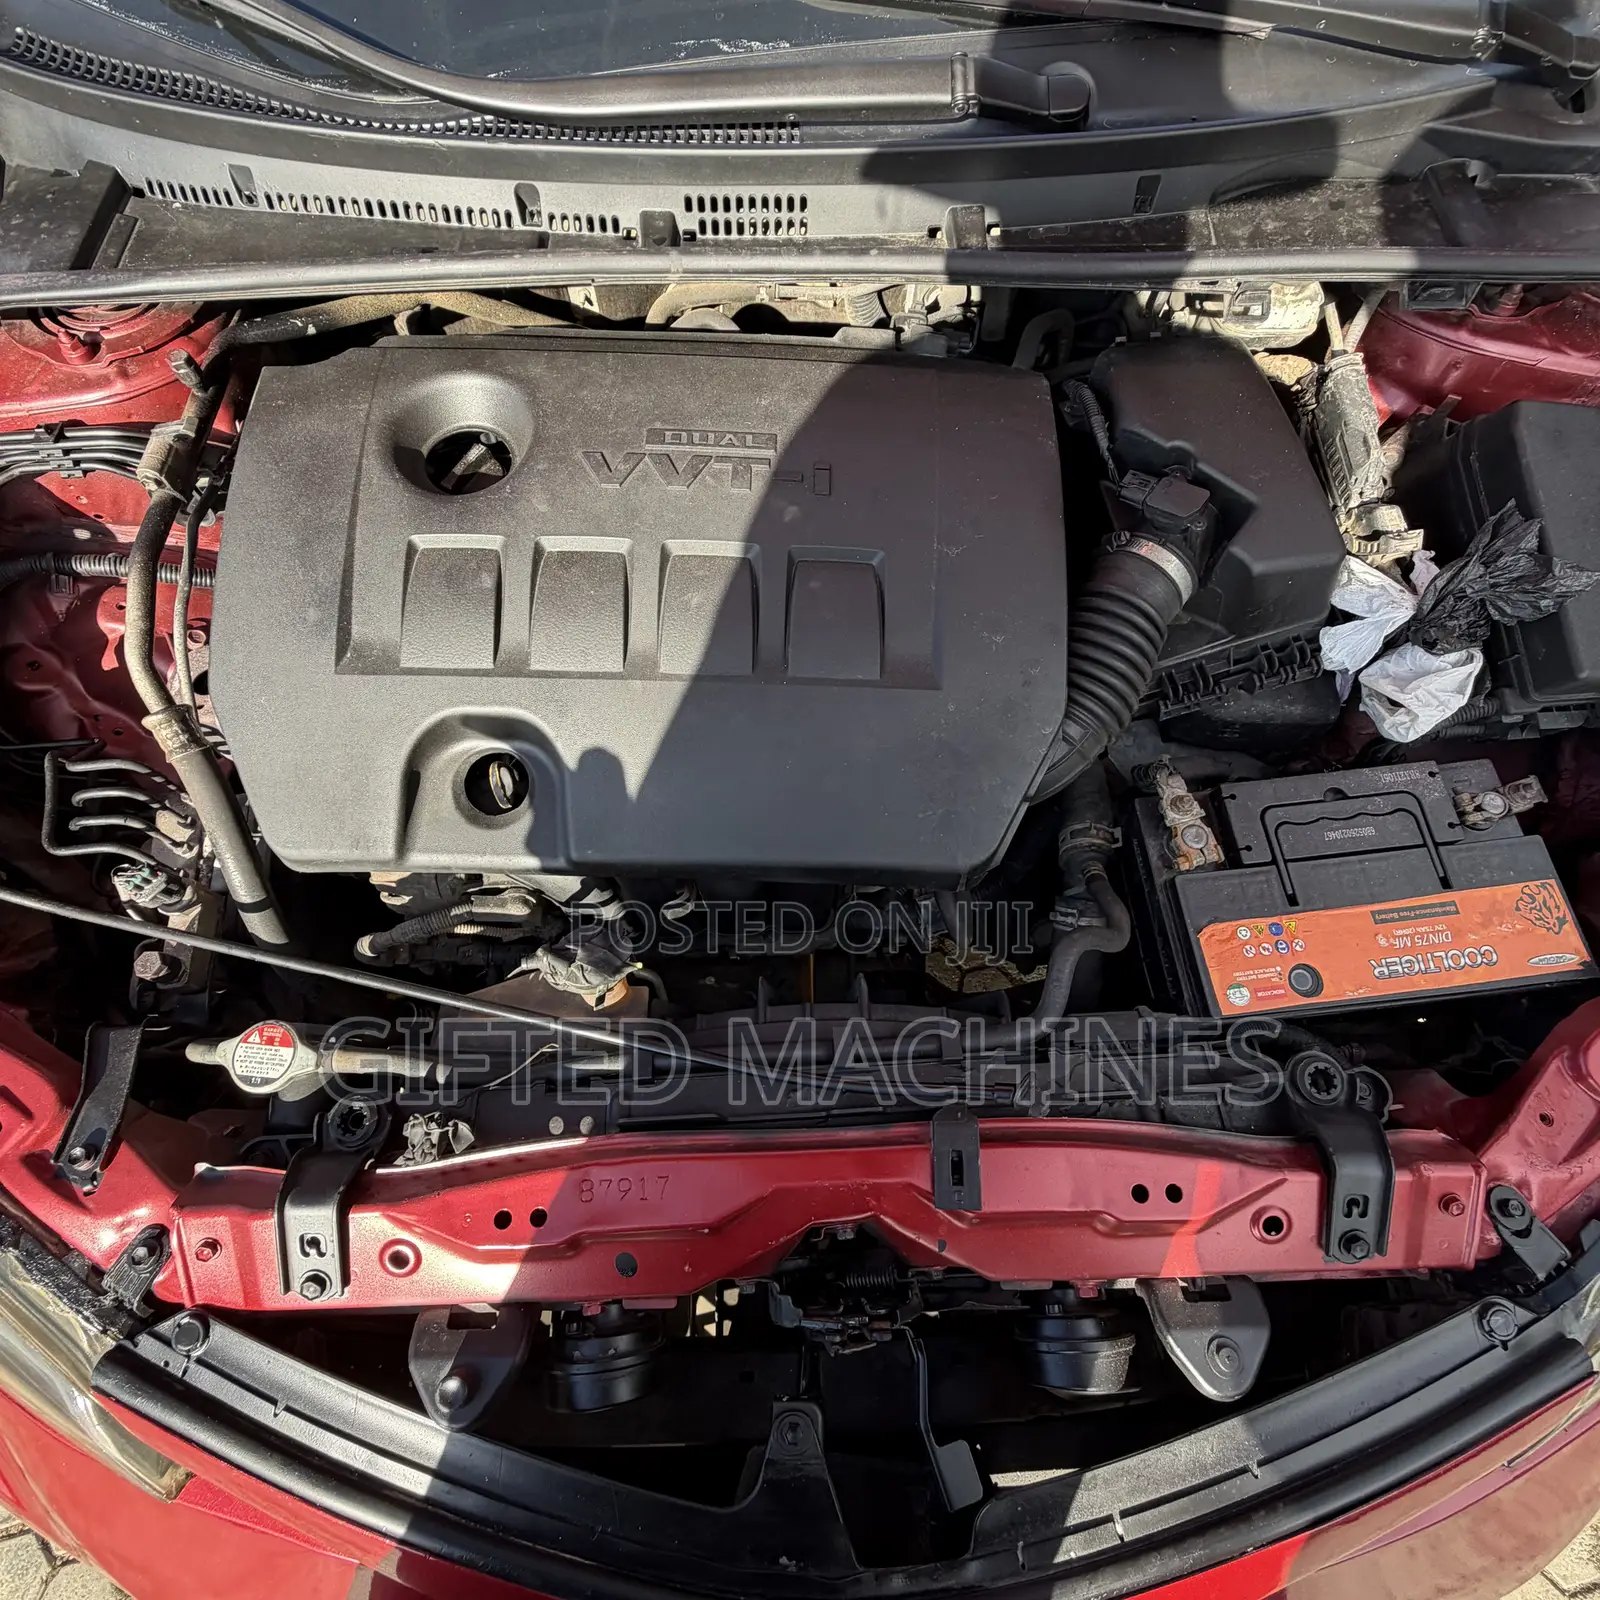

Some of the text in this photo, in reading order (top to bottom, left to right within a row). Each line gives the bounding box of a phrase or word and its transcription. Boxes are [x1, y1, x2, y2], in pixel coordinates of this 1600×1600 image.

[664, 431, 767, 447] DUAL
[1375, 905, 1457, 920] Maintenance-Free Battery
[1414, 931, 1452, 946] DIN75
[1368, 944, 1498, 980] COOLTIGER
[1256, 989, 1286, 997] INDICATOR
[580, 1174, 670, 1203] 87917
